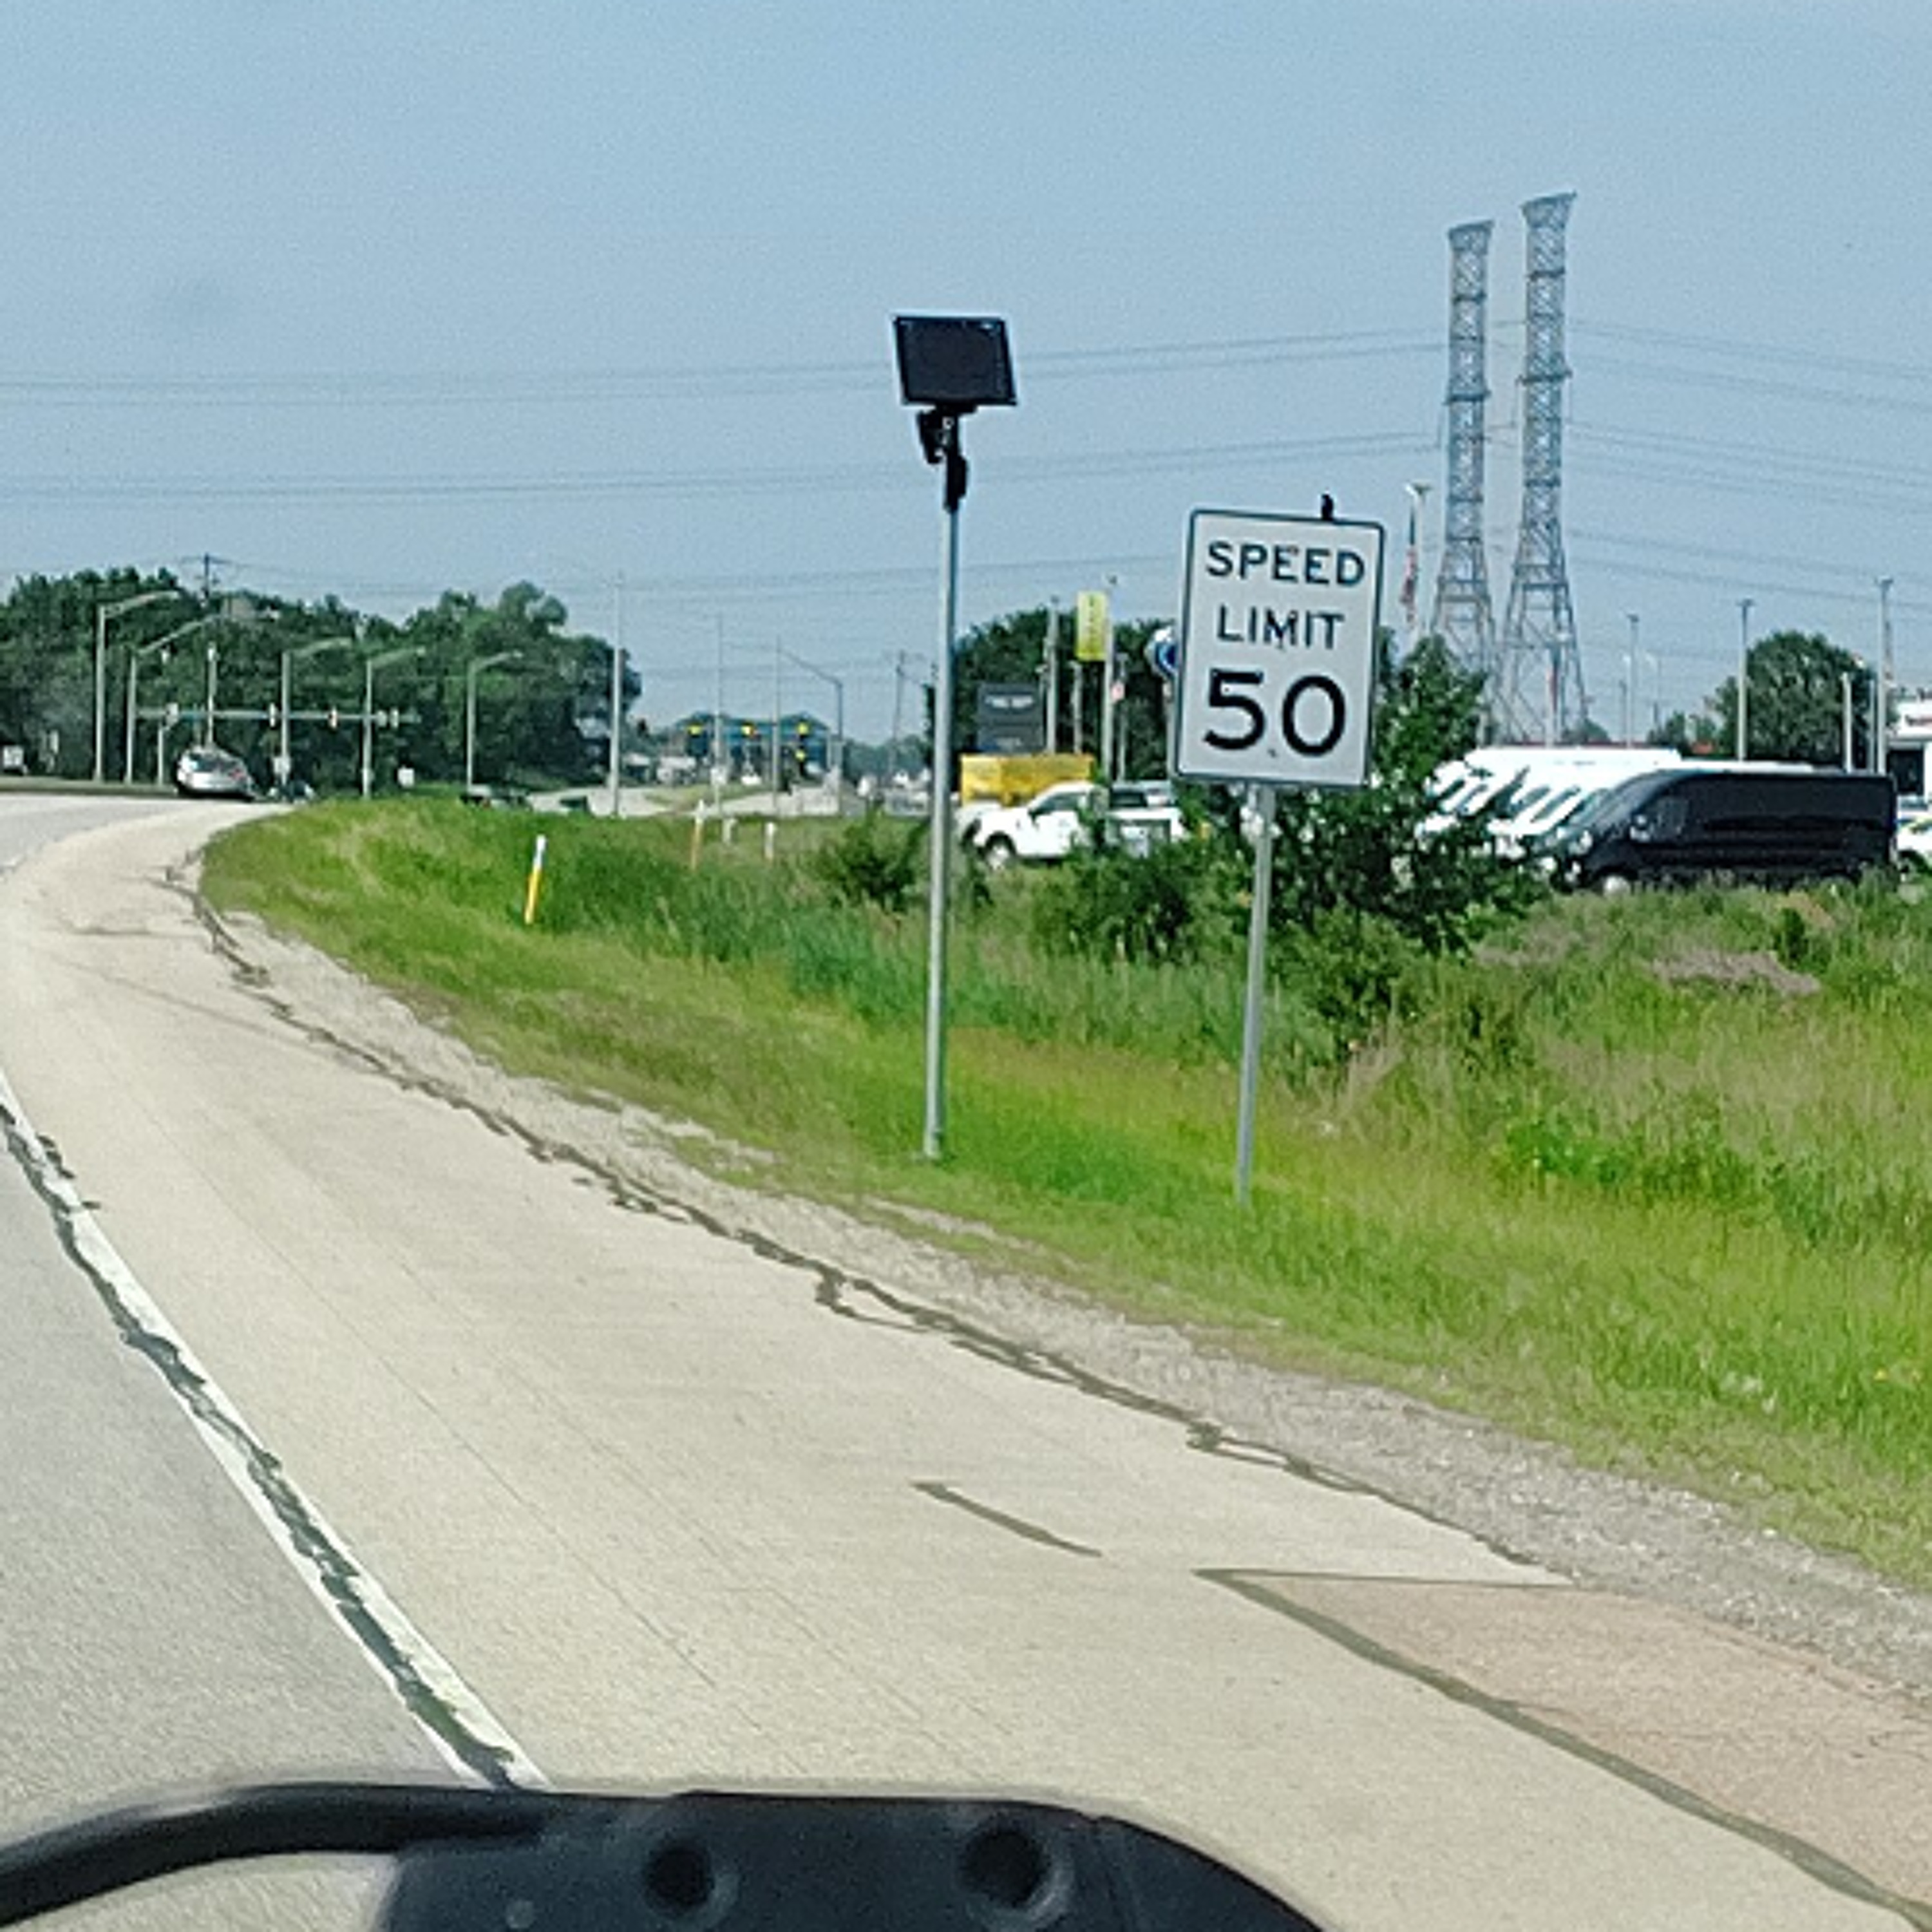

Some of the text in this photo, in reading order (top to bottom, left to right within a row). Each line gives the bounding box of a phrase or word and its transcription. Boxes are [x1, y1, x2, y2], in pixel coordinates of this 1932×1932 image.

[1206, 541, 1365, 585] SPEED
[1217, 605, 1345, 649] LIMIT
[1203, 668, 1346, 757] 50
